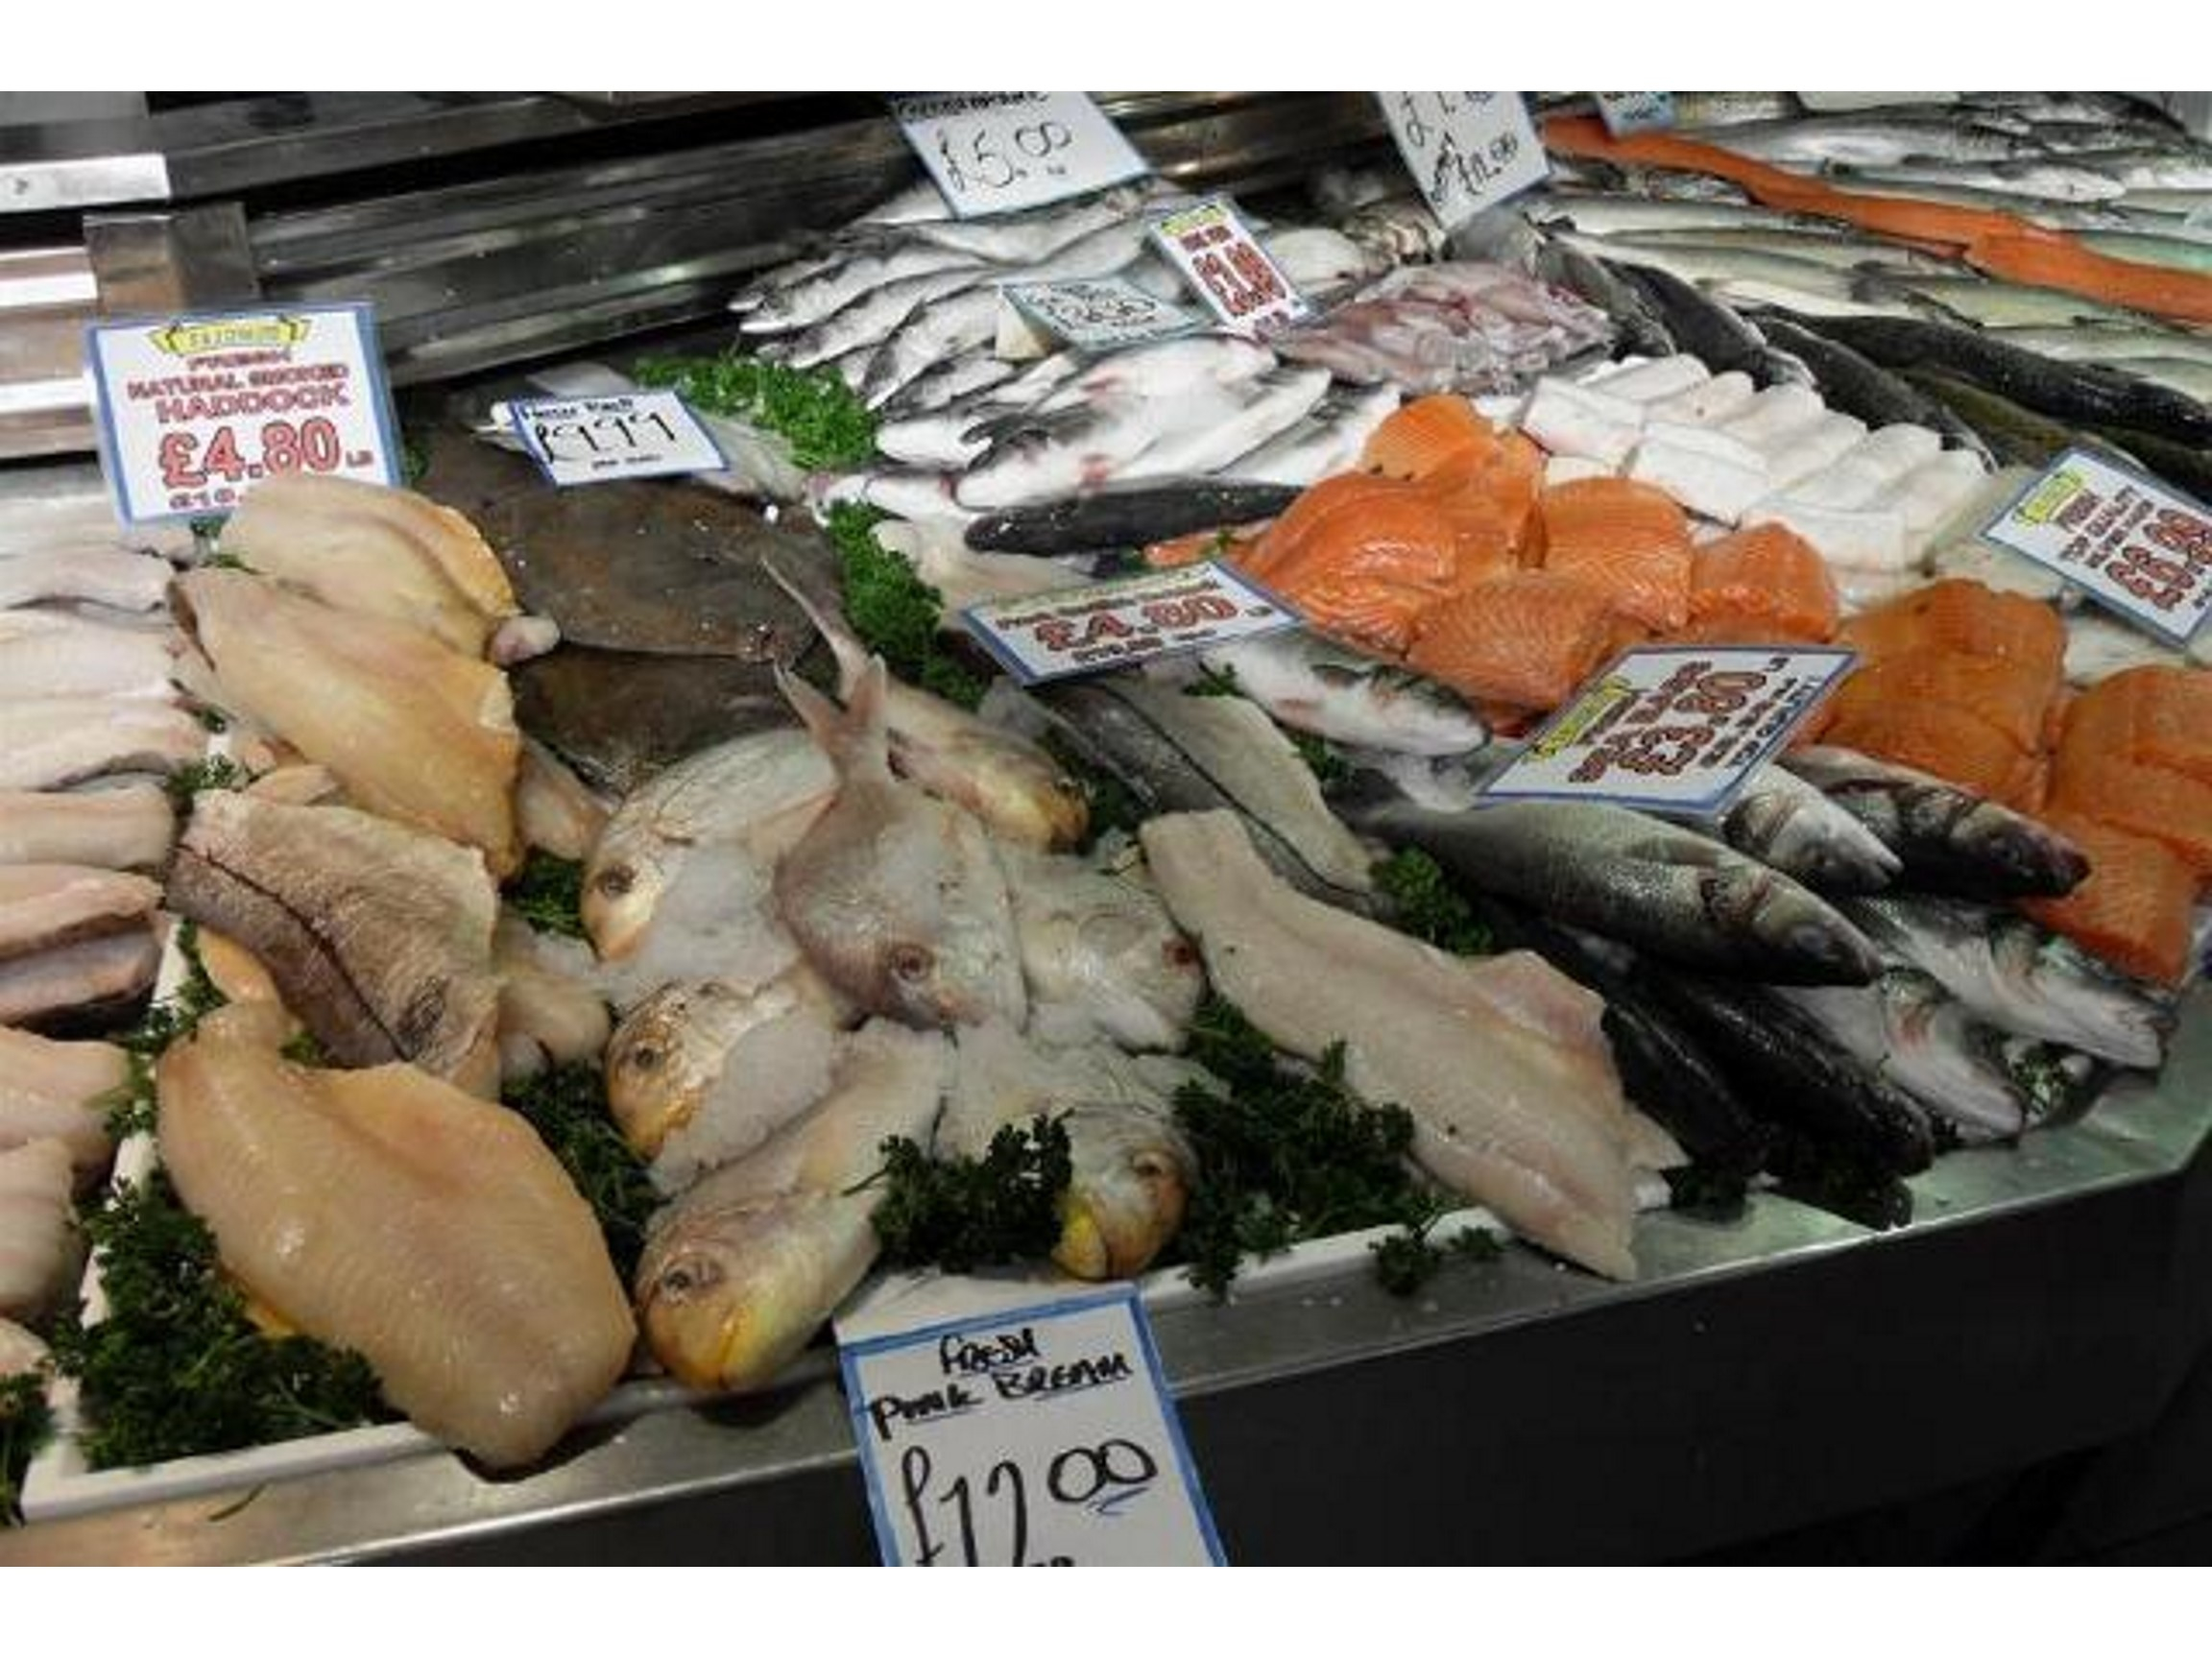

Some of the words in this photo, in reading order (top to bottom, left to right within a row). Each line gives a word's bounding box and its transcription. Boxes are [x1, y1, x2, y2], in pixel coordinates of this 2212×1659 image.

[127, 372, 241, 400] NATURAL
[155, 381, 351, 424] HADDOCK
[158, 416, 340, 491] £4.80
